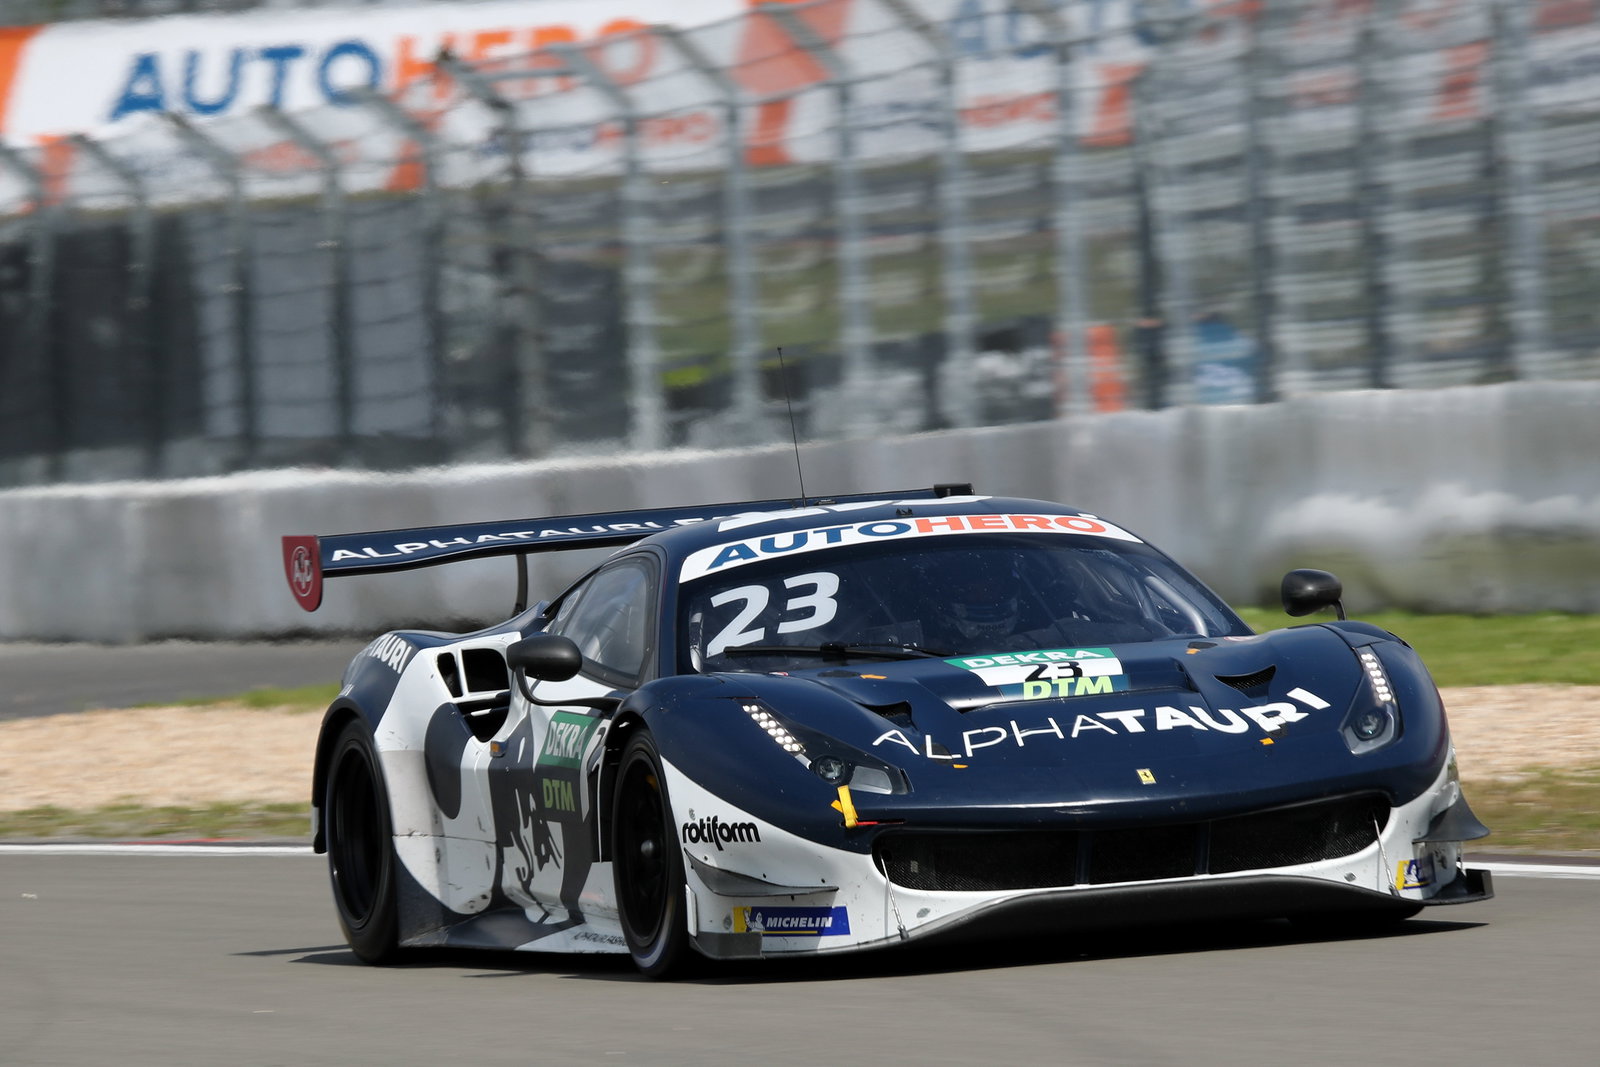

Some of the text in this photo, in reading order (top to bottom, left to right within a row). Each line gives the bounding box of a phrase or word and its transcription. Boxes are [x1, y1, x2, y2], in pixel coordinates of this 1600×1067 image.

[107, 19, 657, 122] AUTOHERO
[706, 514, 1107, 570] AUTOHERO
[707, 571, 840, 659] 23
[962, 650, 1104, 668] DEKRA
[1020, 661, 1083, 683] 23
[1023, 675, 1114, 700] DTM
[545, 720, 588, 760] DEKRA
[872, 687, 1332, 760] ALPHATAURI
[542, 777, 576, 812] DTM
[682, 815, 762, 851] rotiform
[766, 916, 833, 929] MICHELIN
